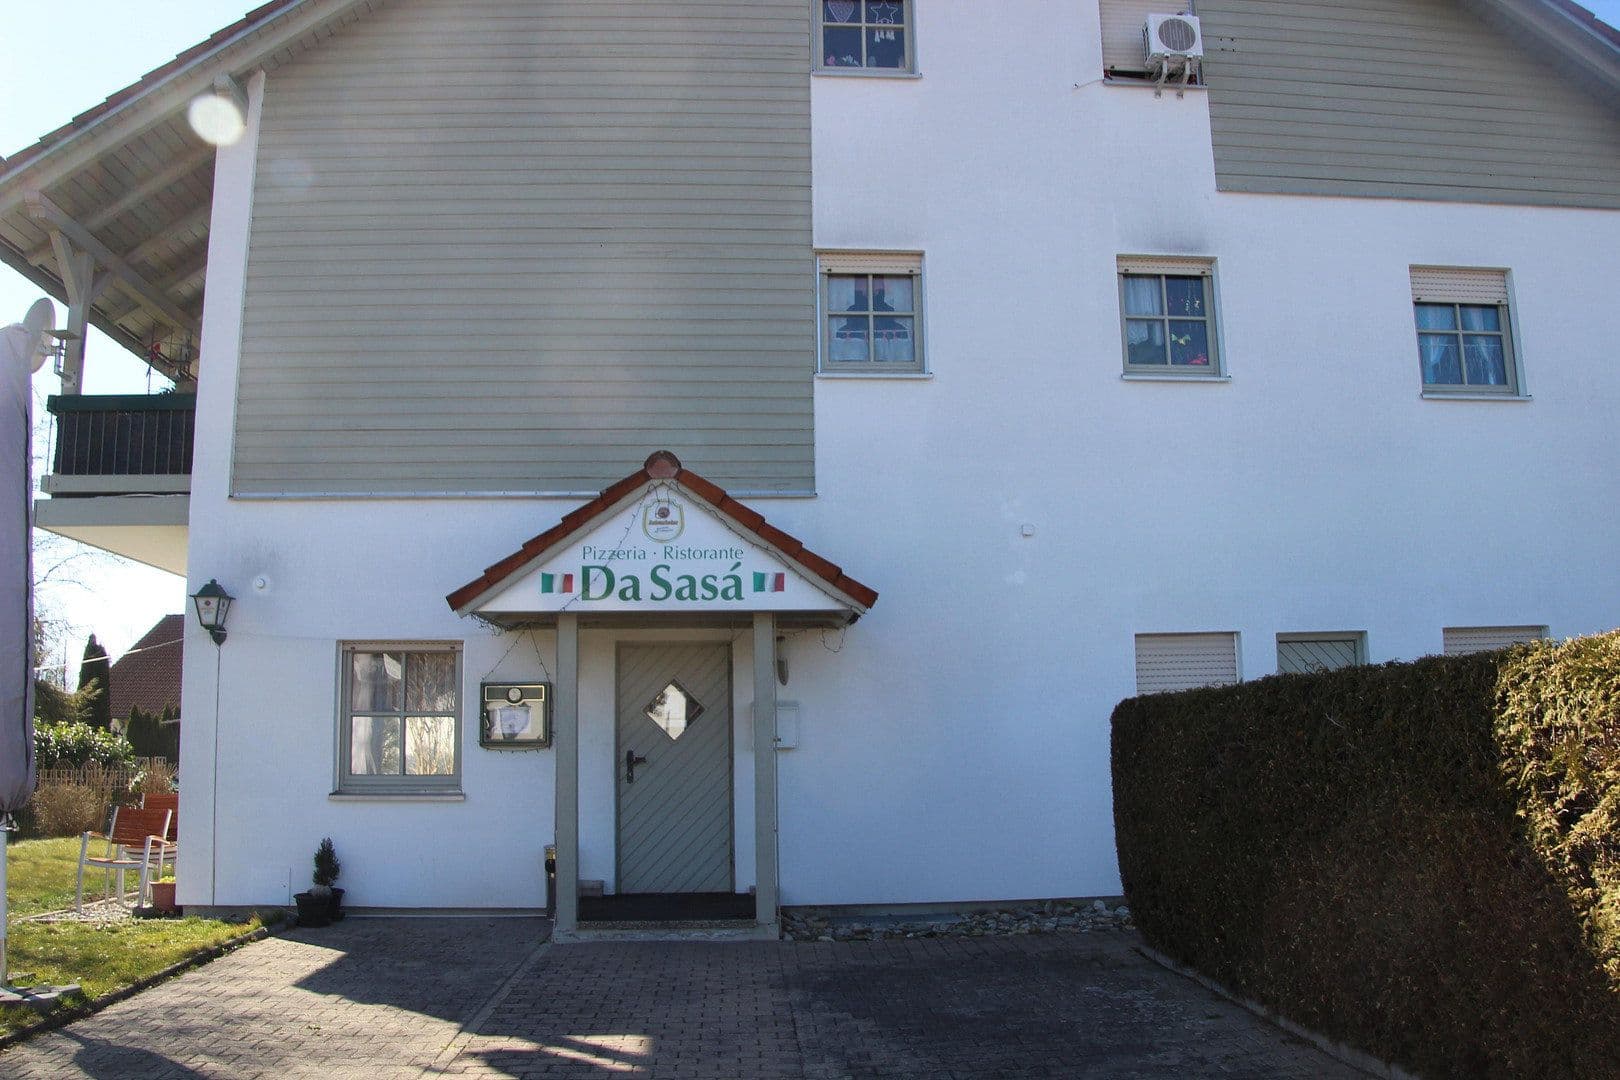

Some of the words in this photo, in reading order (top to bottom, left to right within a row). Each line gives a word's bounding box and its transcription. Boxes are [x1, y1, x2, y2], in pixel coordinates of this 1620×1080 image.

[582, 545, 646, 560] Pizzeria
[663, 545, 744, 560] Ristorante
[581, 565, 642, 602] Da
[650, 561, 745, 602] Sasá
